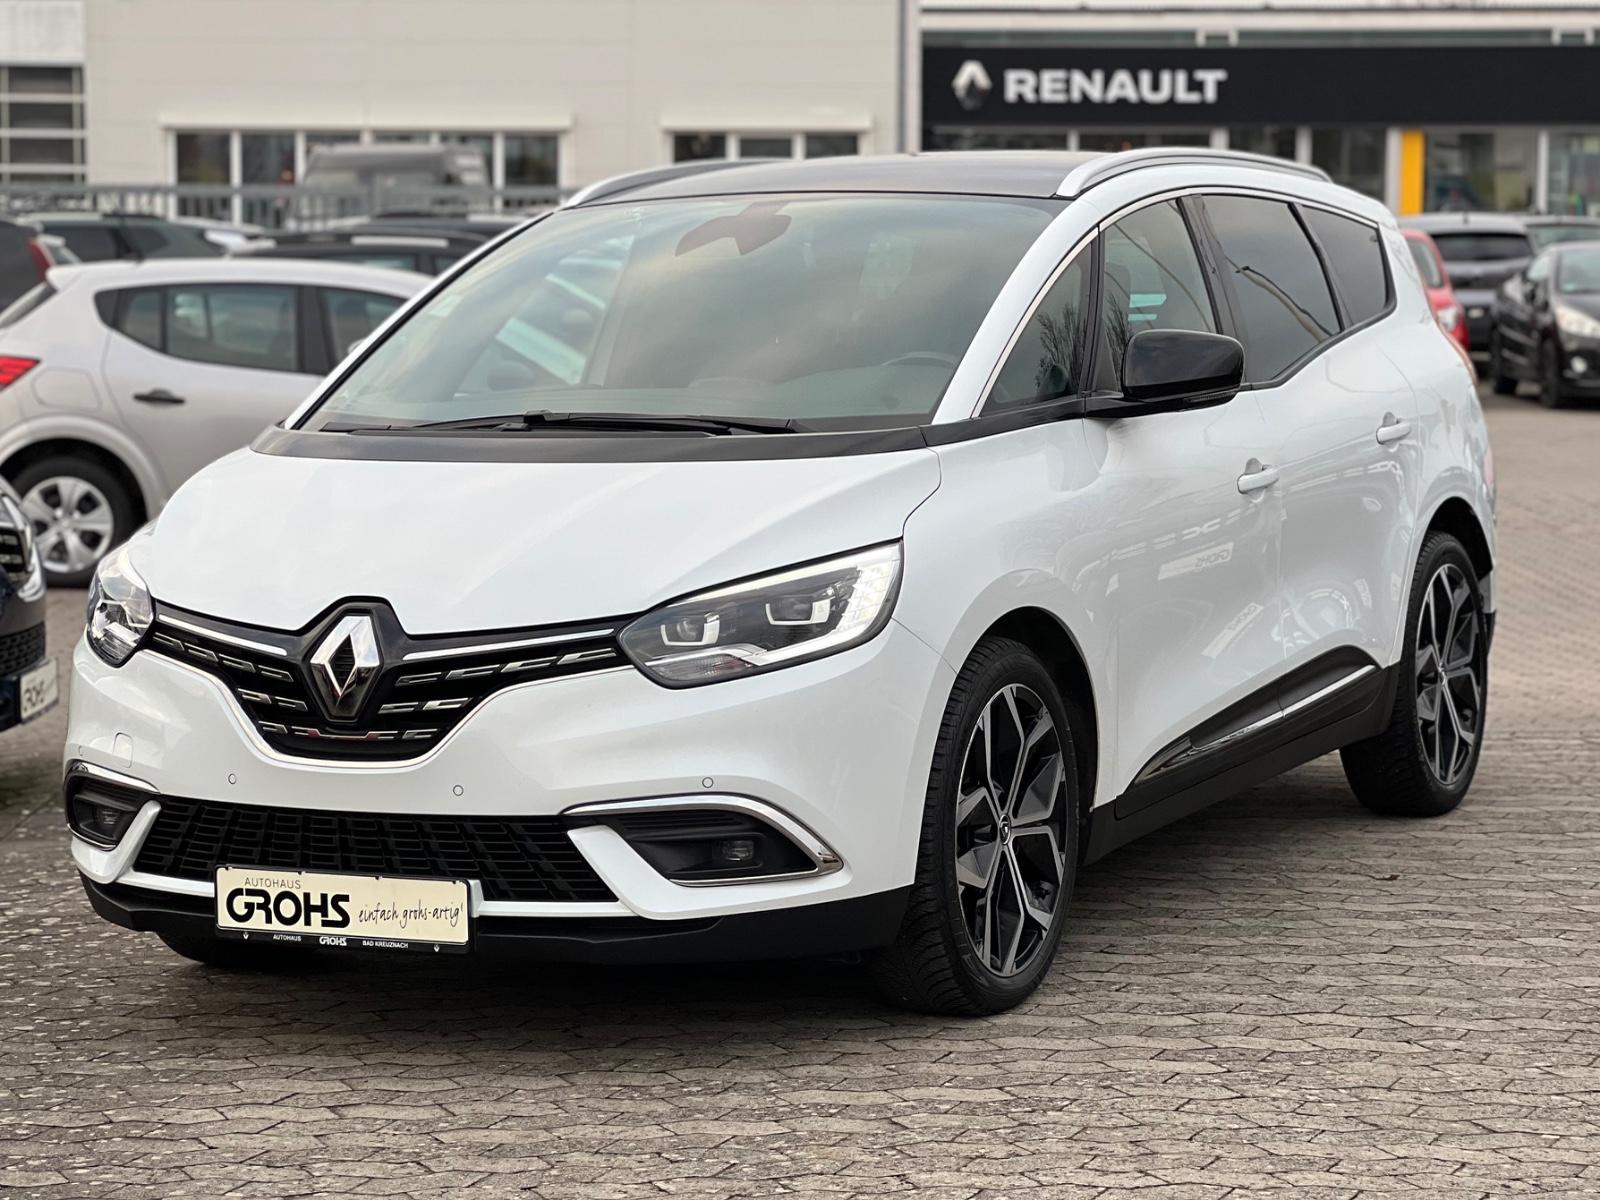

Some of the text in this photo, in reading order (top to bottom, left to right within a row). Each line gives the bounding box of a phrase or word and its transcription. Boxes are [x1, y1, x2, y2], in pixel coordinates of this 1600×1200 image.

[1003, 68, 1228, 104] RENAULT
[244, 876, 301, 890] AUTOHAUS
[226, 887, 351, 928] GROHS
[358, 901, 399, 925] einfach
[272, 934, 302, 942] AUTOHAUS
[319, 936, 347, 946] GROHS
[375, 941, 409, 949] KREUZNACH
